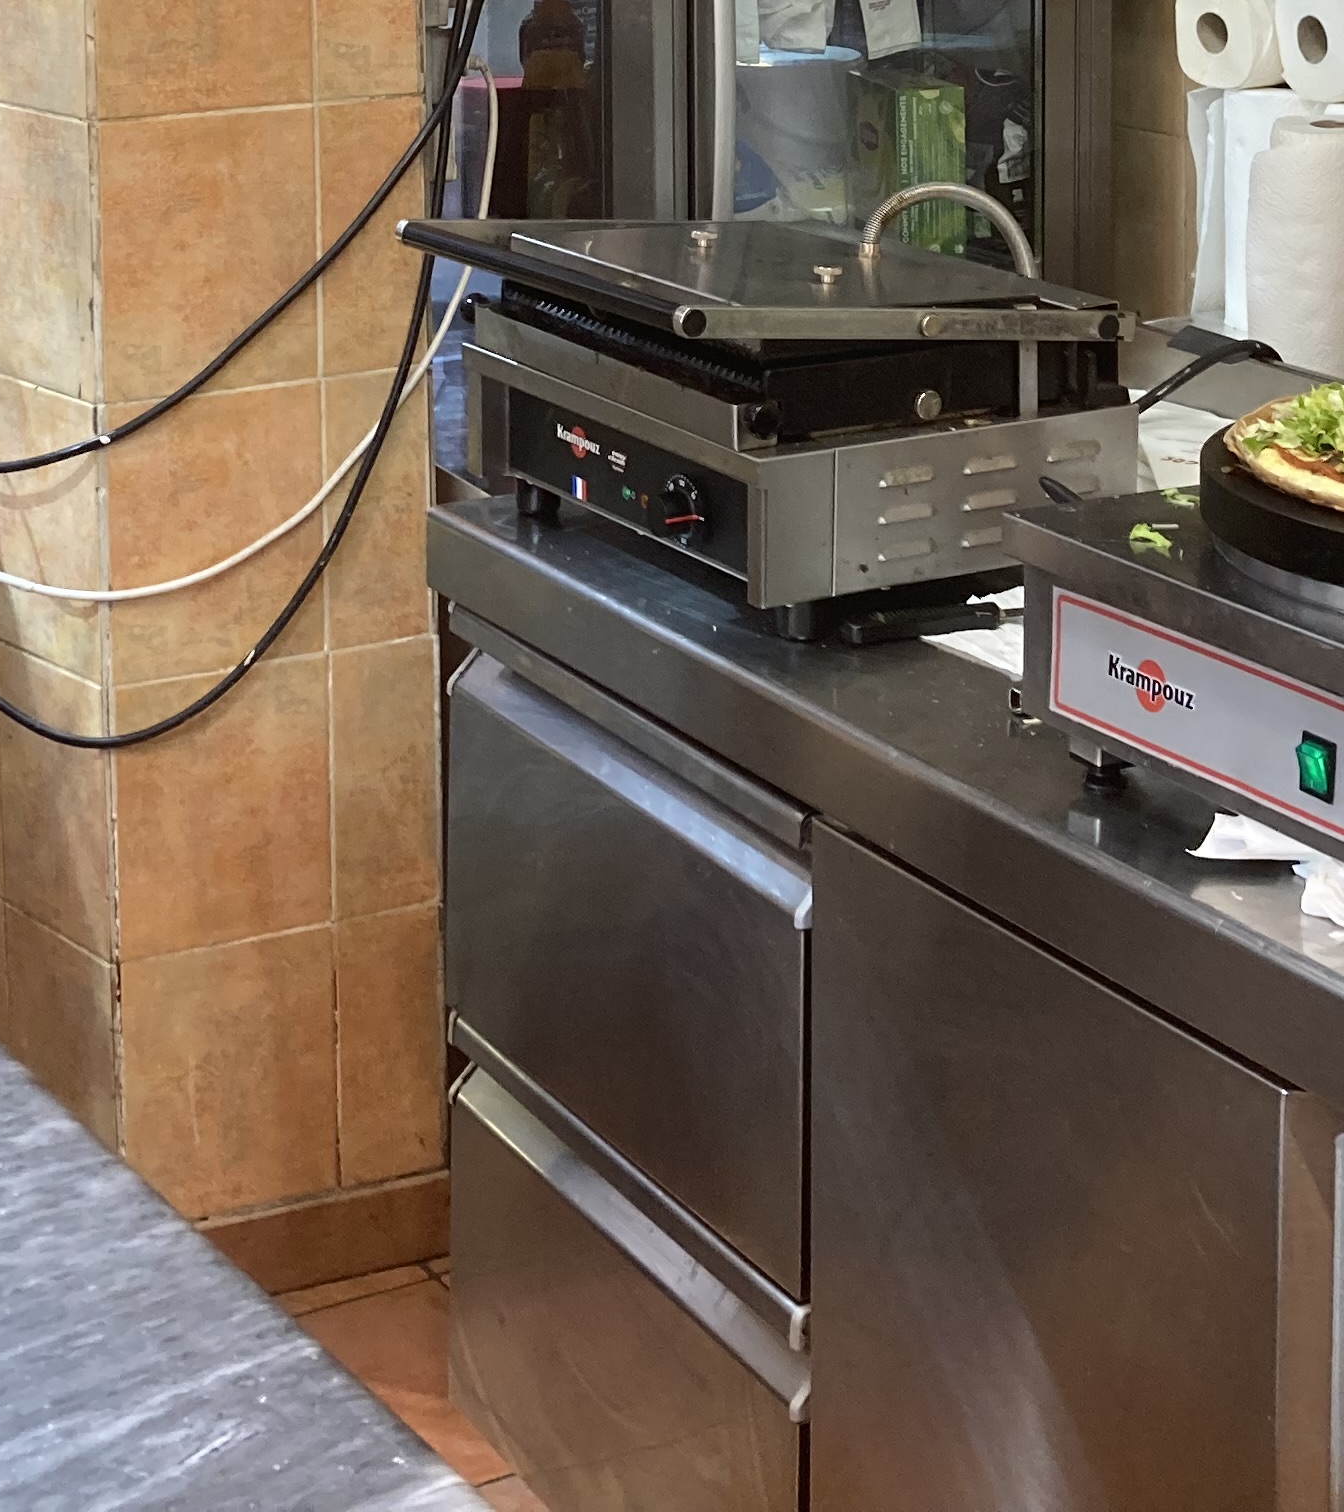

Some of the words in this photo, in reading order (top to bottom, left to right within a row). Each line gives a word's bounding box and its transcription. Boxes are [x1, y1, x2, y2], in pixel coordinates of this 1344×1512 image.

[899, 95, 907, 156] ENGAGEMENTS
[556, 423, 601, 456] Krampouz
[1107, 652, 1196, 711] Krampouz
